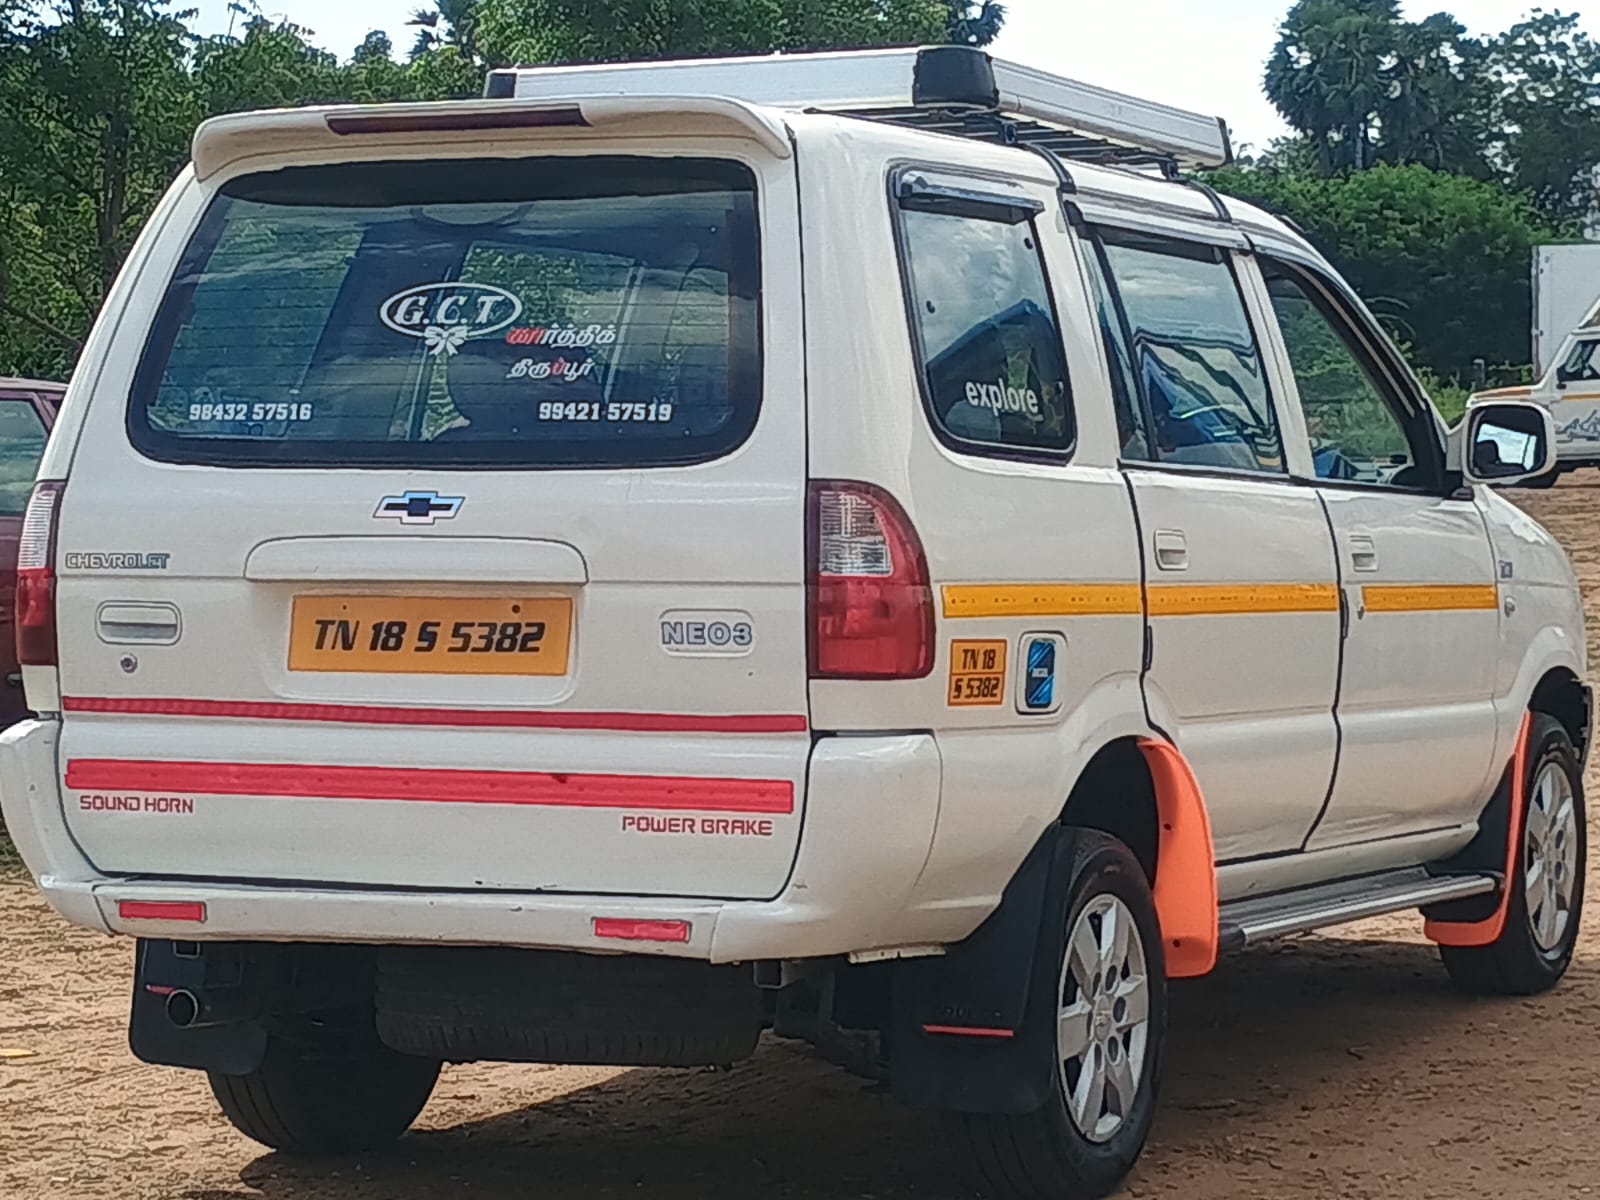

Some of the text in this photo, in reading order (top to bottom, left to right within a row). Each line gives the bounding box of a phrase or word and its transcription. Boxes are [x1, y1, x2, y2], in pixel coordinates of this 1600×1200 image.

[965, 377, 1038, 416] explore
[189, 403, 312, 420] 98432 57516
[539, 402, 672, 421] 99421 57519
[65, 552, 171, 569] CHEVROLET
[315, 619, 546, 652] TN 18 S 5382
[661, 621, 753, 645] NEO3
[962, 649, 996, 670] TN 18
[966, 677, 999, 698] 5382
[80, 795, 193, 813] SOUND HORN
[622, 816, 773, 836] POWER BRAKE
